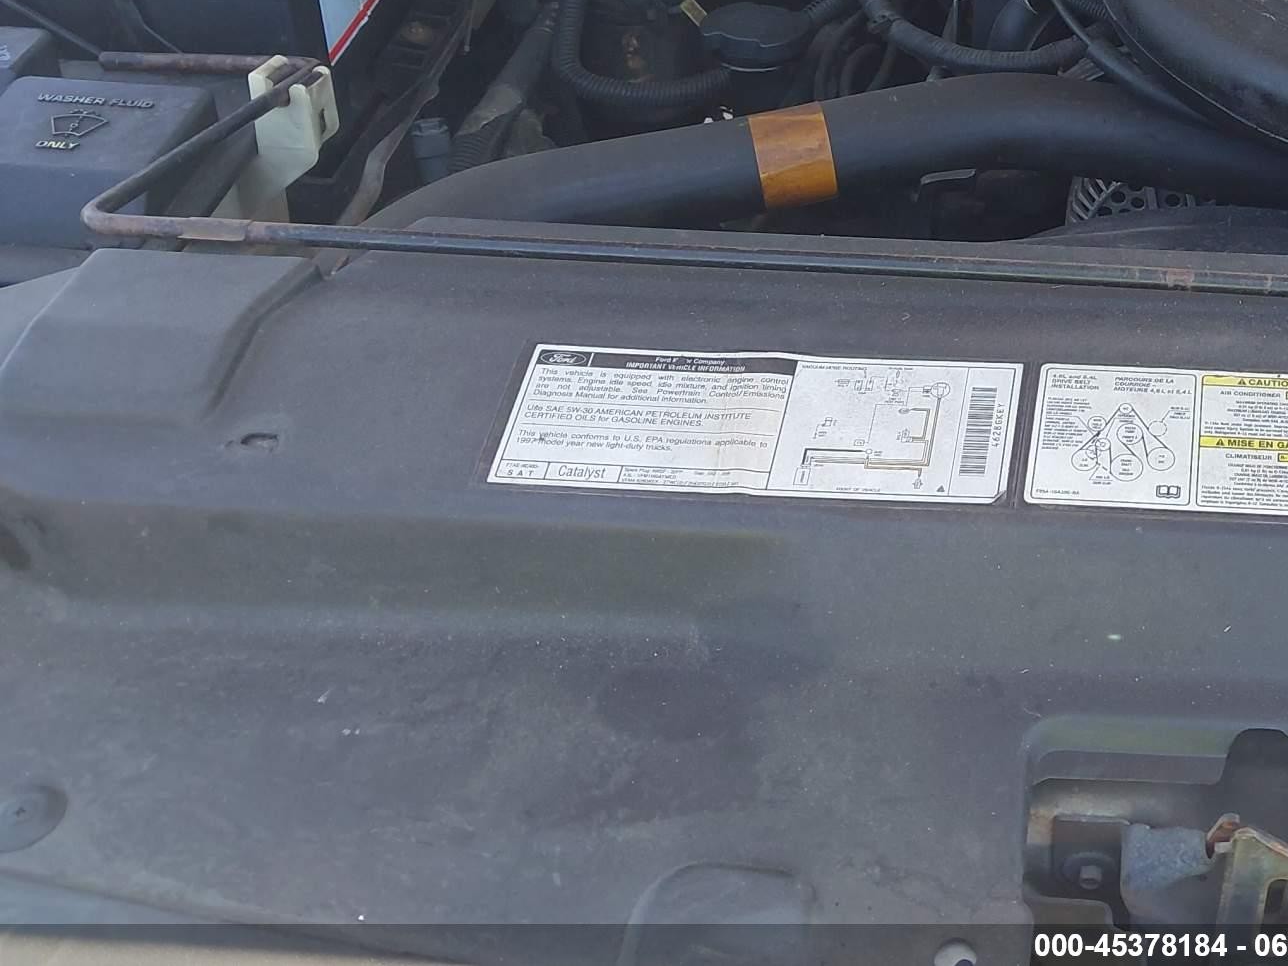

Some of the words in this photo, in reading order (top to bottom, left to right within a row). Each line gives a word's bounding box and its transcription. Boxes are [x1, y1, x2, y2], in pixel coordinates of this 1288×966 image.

[37, 92, 105, 107] WASHER
[109, 96, 155, 110] FLUID
[34, 139, 81, 152] ONLY
[548, 353, 579, 365] Ford
[693, 358, 726, 366] Company
[625, 362, 667, 371] IMPORTANT
[668, 363, 696, 372] VEHICLE
[698, 365, 746, 373] INFORMATION
[541, 367, 558, 375] This
[565, 369, 594, 377] vehicle
[613, 372, 652, 381] equipped
[658, 373, 675, 381] with
[680, 375, 721, 384] electronic
[727, 377, 755, 385] engine
[760, 377, 790, 385] control
[557, 383, 571, 391] not
[631, 387, 648, 395] See
[656, 388, 701, 397] Powertrain
[708, 390, 786, 401] Control/Emissions
[577, 377, 606, 386] Engine
[609, 378, 624, 386] idle
[711, 383, 727, 391] and
[730, 383, 759, 392] ignition
[762, 384, 787, 394] timing
[532, 388, 574, 398] Diagnosis
[575, 390, 607, 399] Manual
[620, 393, 660, 403] additional
[1233, 390, 1281, 399] CONDITIONER
[523, 411, 573, 421] CERTIFIED
[574, 414, 596, 422] OILS
[598, 415, 609, 423] for
[610, 416, 659, 426] GASOLINE
[660, 418, 705, 427] ENGINES.
[545, 405, 564, 413] SAE
[565, 406, 594, 414] 5W-30
[595, 407, 643, 418] AMERICAN
[645, 410, 702, 421] PETROLEUM
[703, 412, 752, 421] INSTITUTE
[519, 429, 536, 437] This
[540, 430, 568, 439] vehicle
[570, 432, 609, 440] conforms
[624, 434, 642, 443] U.S.
[645, 435, 663, 443] EPA
[666, 437, 712, 447] regulations
[714, 438, 756, 448] applicable
[565, 440, 584, 449] year
[604, 440, 643, 451] light-duty
[645, 443, 673, 452] trucks.
[1227, 439, 1255, 448] MISE
[1258, 440, 1274, 449] EN
[1225, 452, 1273, 461] CLIMATISEUR
[557, 464, 607, 480] Catalyst
